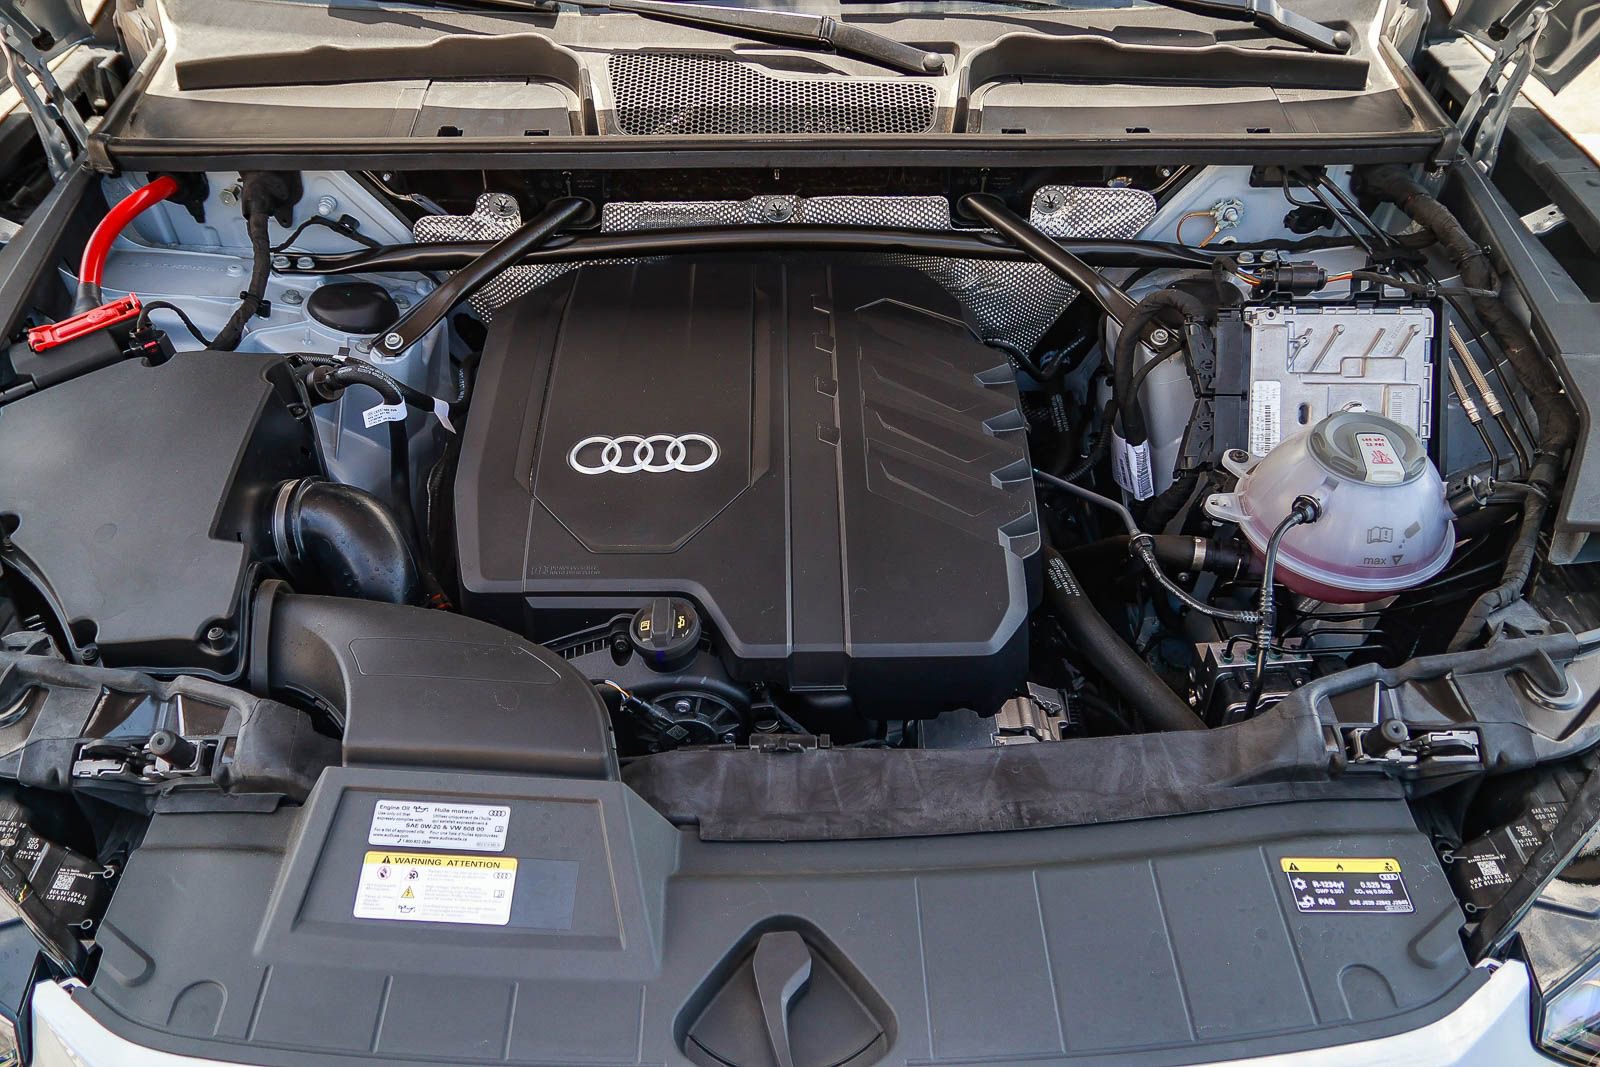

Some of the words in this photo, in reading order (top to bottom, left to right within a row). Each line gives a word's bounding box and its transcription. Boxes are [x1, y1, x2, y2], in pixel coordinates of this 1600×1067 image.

[394, 857, 441, 866] WARNING
[447, 860, 501, 869] ATTENTION
[1312, 880, 1344, 889] R-1234yf
[1380, 882, 1391, 890] kg
